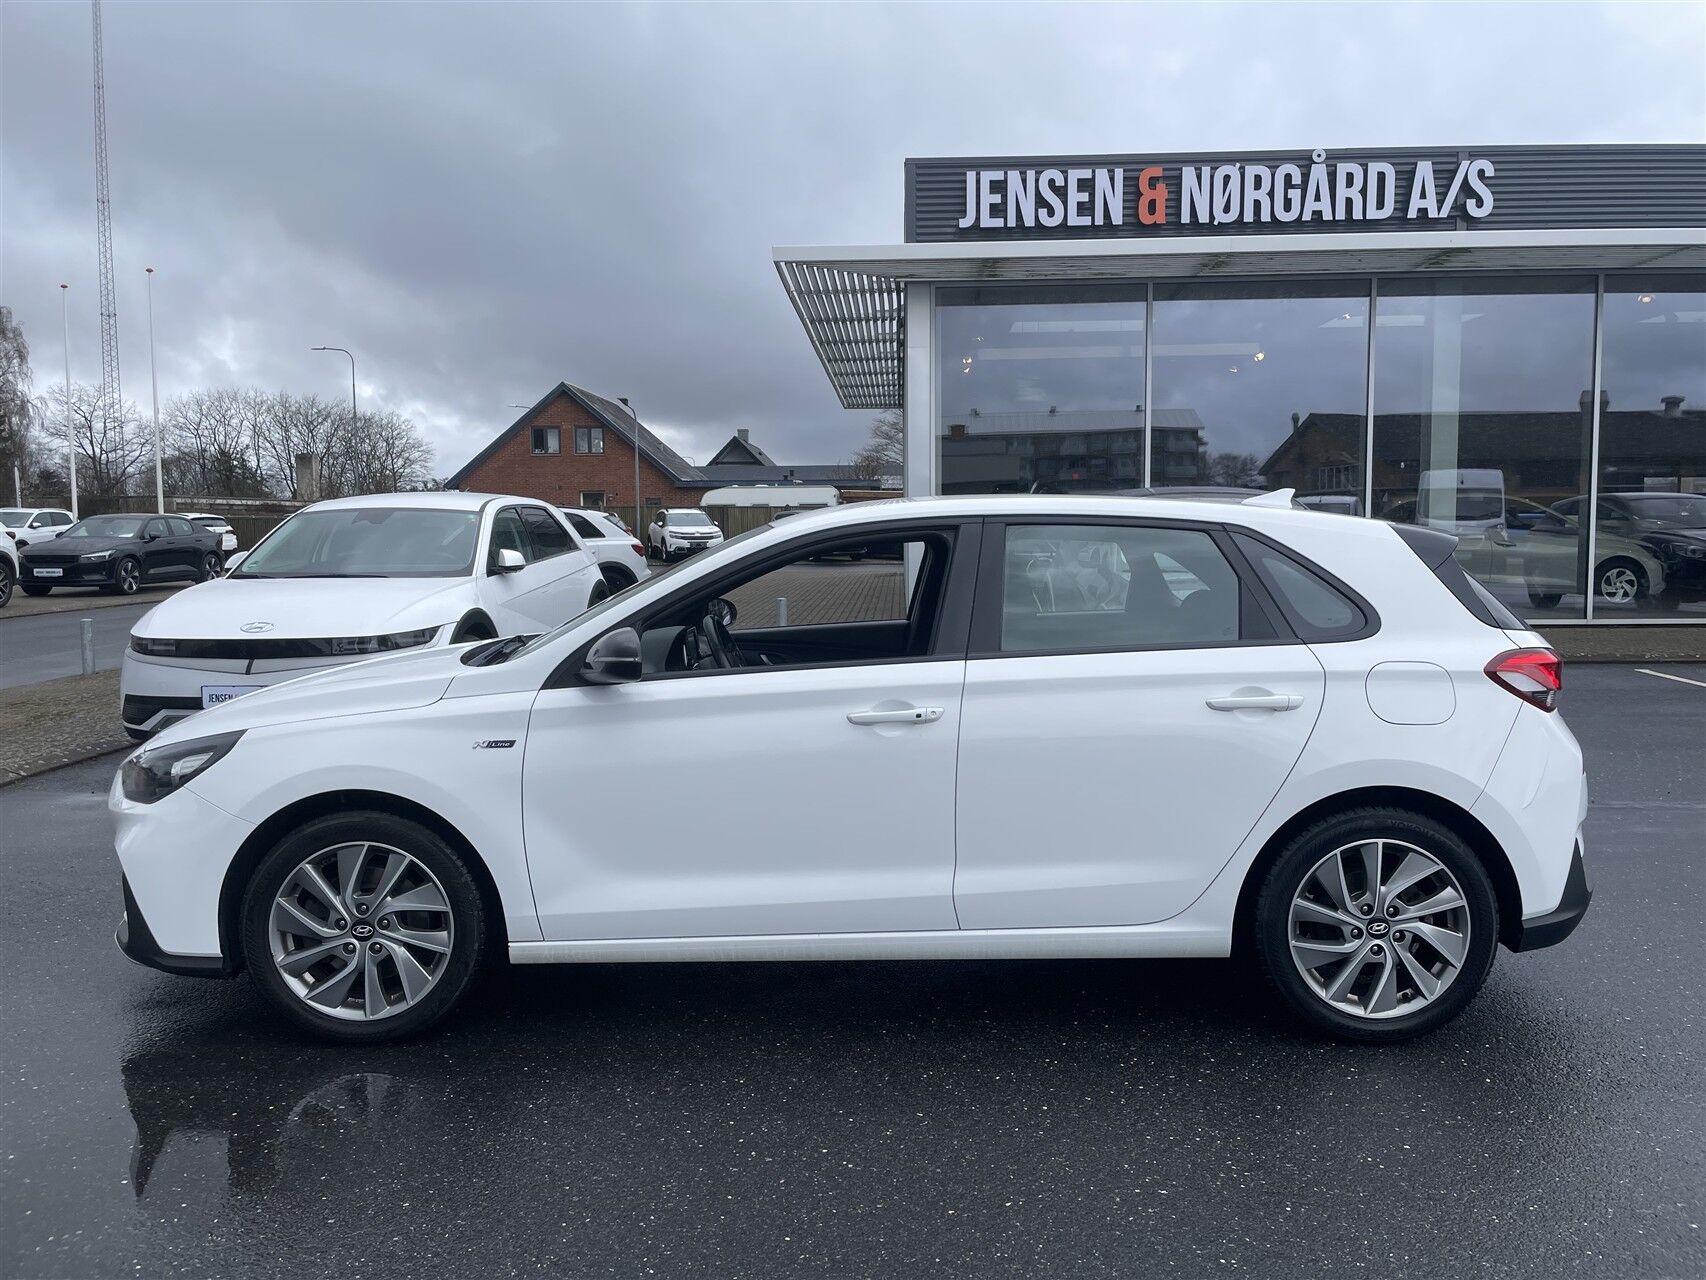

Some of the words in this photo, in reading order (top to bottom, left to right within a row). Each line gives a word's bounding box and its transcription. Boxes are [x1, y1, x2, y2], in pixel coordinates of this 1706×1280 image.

[959, 168, 1124, 228] JENSEN
[1138, 167, 1168, 225] &
[1181, 149, 1395, 226] NØRGÅRD
[1407, 159, 1495, 219] A/S
[208, 694, 233, 702] JENSEN
